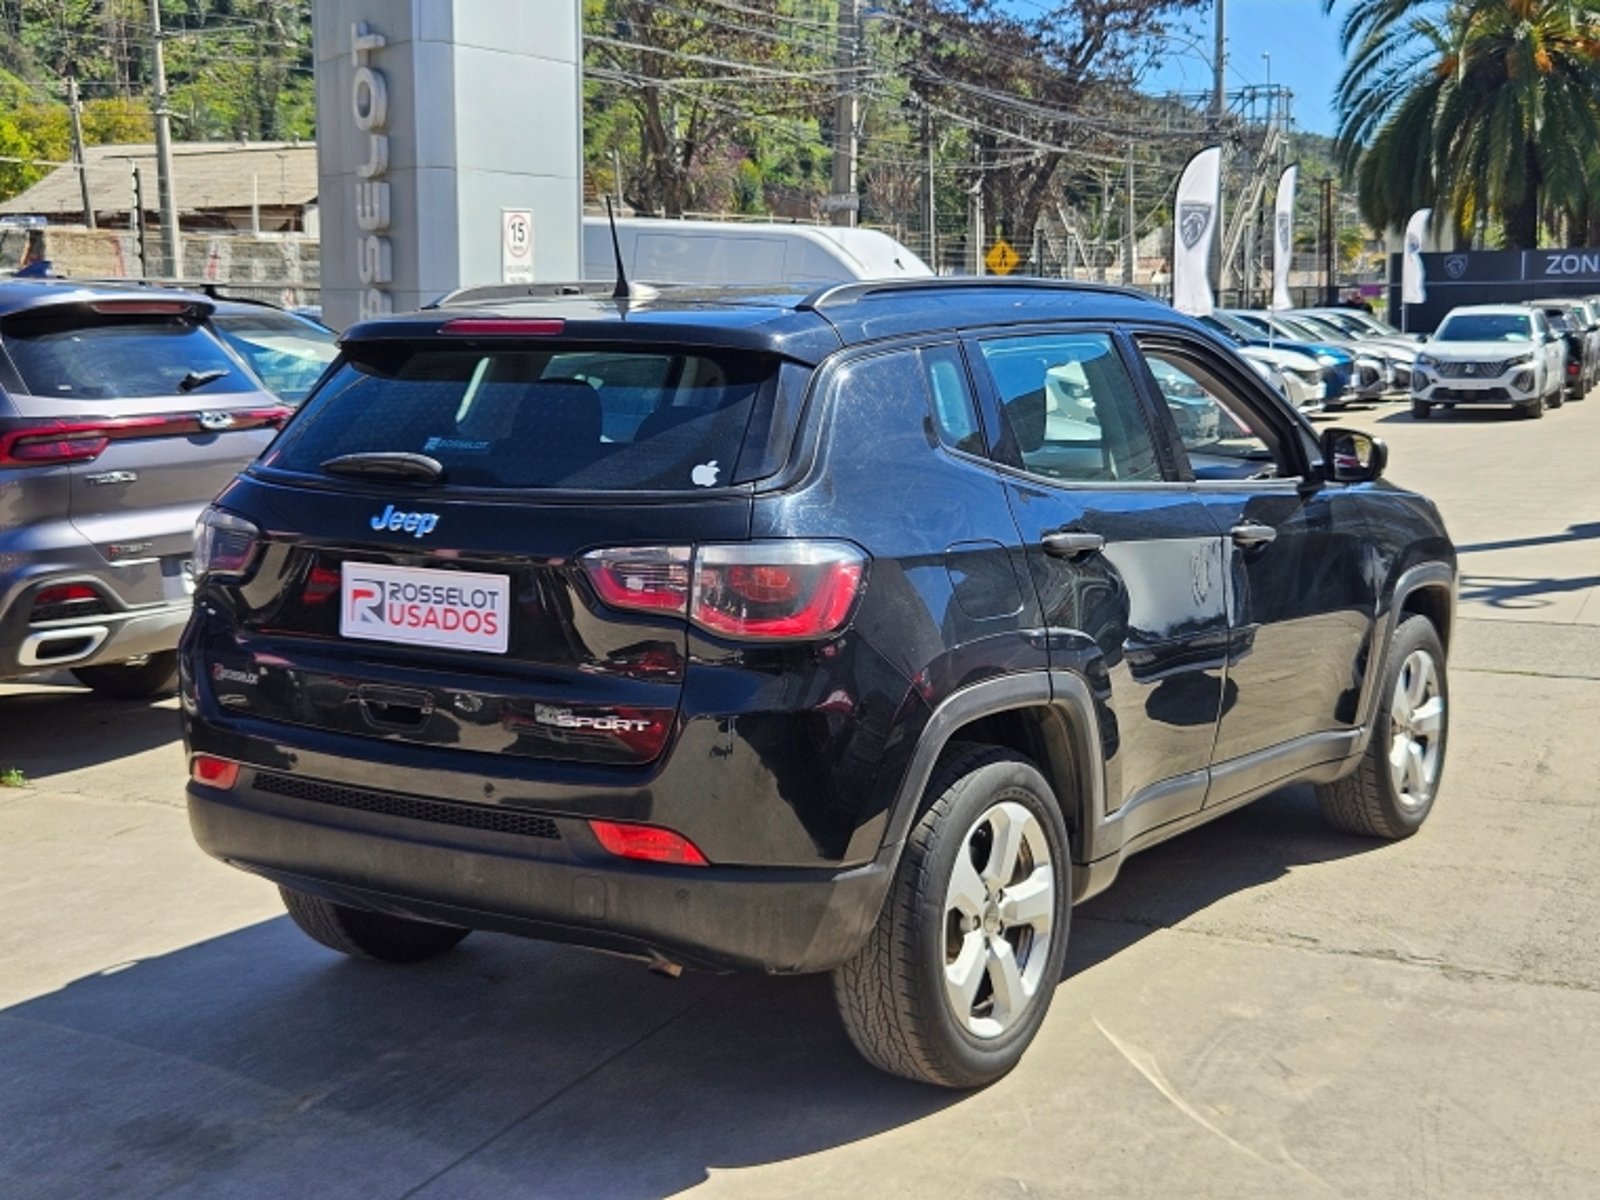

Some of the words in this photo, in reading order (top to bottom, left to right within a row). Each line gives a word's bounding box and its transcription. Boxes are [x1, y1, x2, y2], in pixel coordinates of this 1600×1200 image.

[511, 222, 525, 242] 15
[1545, 254, 1599, 275] ZON
[371, 505, 440, 538] Jeep
[389, 582, 499, 610] ROSSELOT
[388, 603, 498, 636] USADOS
[557, 715, 652, 732] SPORT
